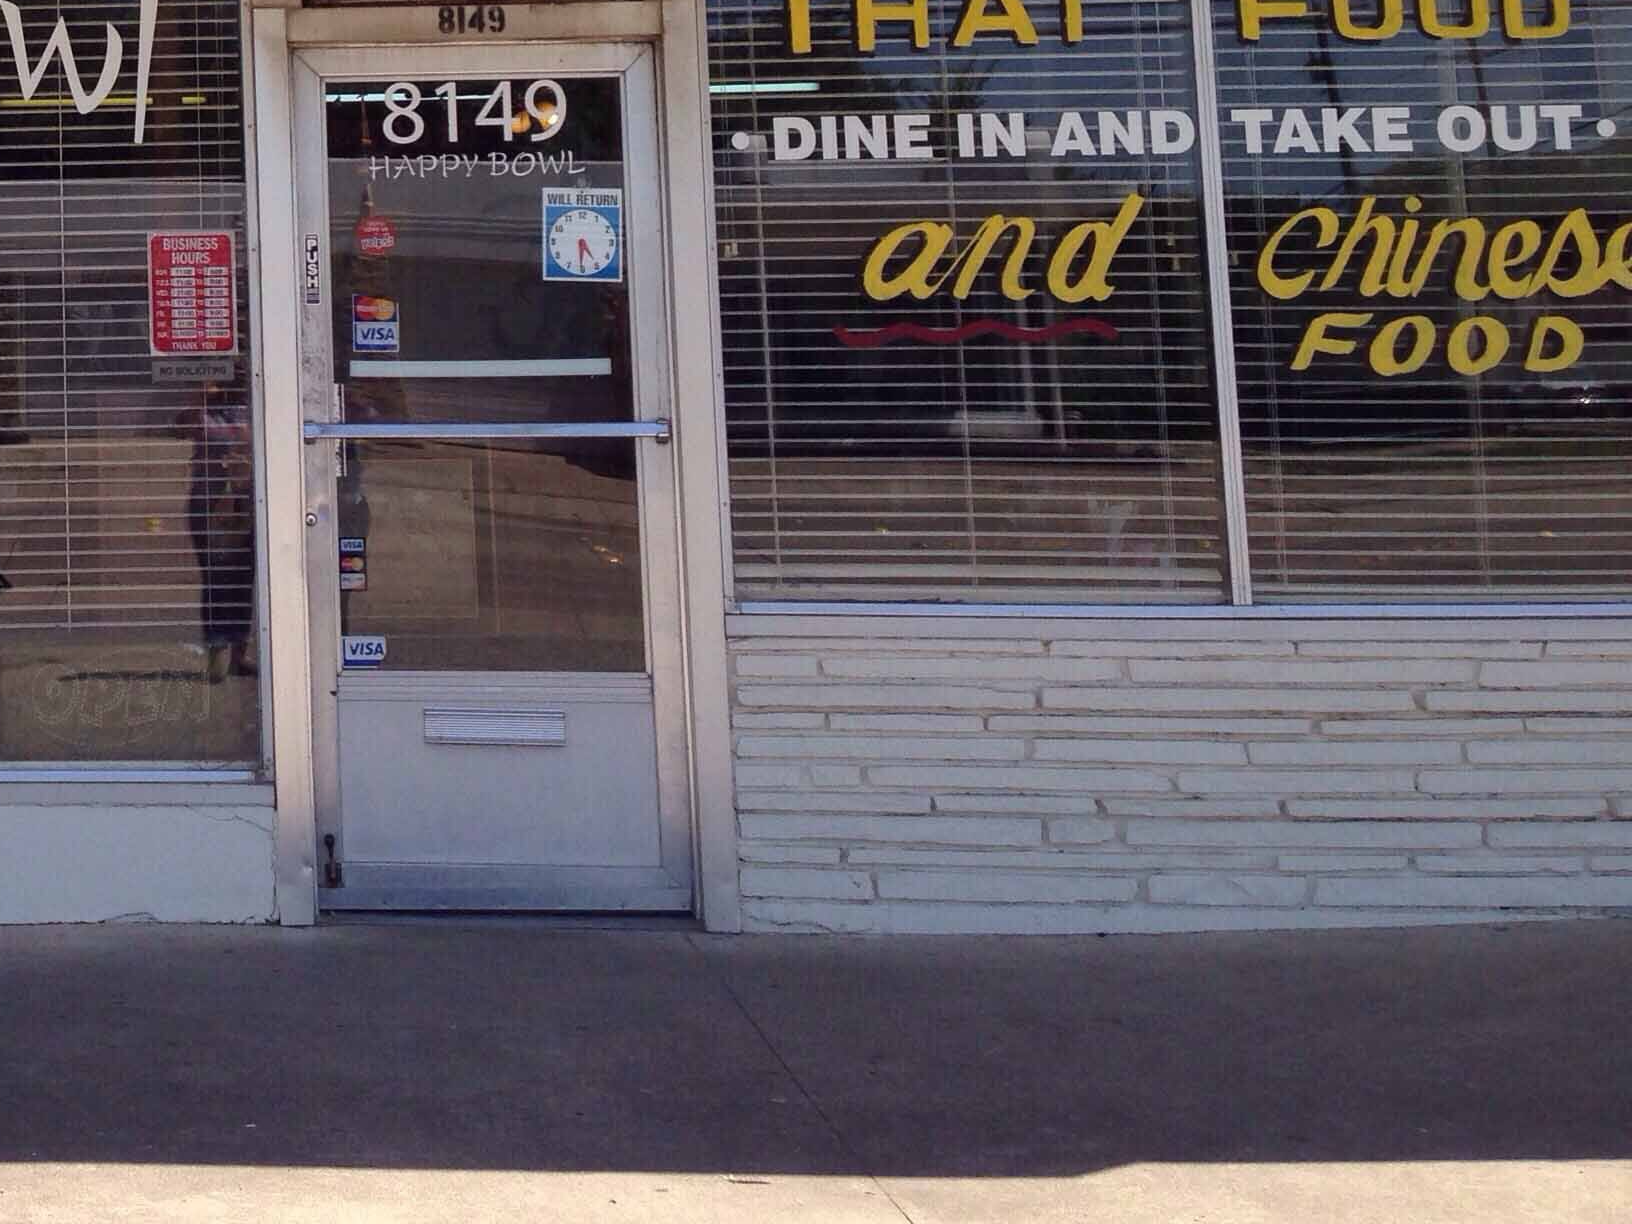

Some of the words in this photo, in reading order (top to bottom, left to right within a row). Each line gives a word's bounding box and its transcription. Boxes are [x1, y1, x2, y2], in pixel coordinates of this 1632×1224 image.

[438, 6, 506, 34] 8149
[381, 79, 568, 145] 8149
[773, 114, 934, 161] DINE
[957, 112, 1027, 157] IN
[1050, 109, 1196, 157] AND
[1231, 105, 1415, 154] TAKE
[1437, 104, 1583, 153] OUT
[368, 153, 480, 181] HAPPY
[488, 150, 587, 177] BOWL
[547, 193, 573, 205] WILL
[576, 194, 618, 206] RETURN
[162, 238, 218, 250] BUSINESS
[171, 252, 210, 264] HOURS
[862, 191, 1145, 304] and
[306, 239, 318, 288] PUSH
[171, 341, 198, 350] THANK
[201, 341, 217, 350] YOU
[360, 327, 395, 340] VISA
[1290, 312, 1585, 376] FOOD
[350, 642, 384, 656] VISA
